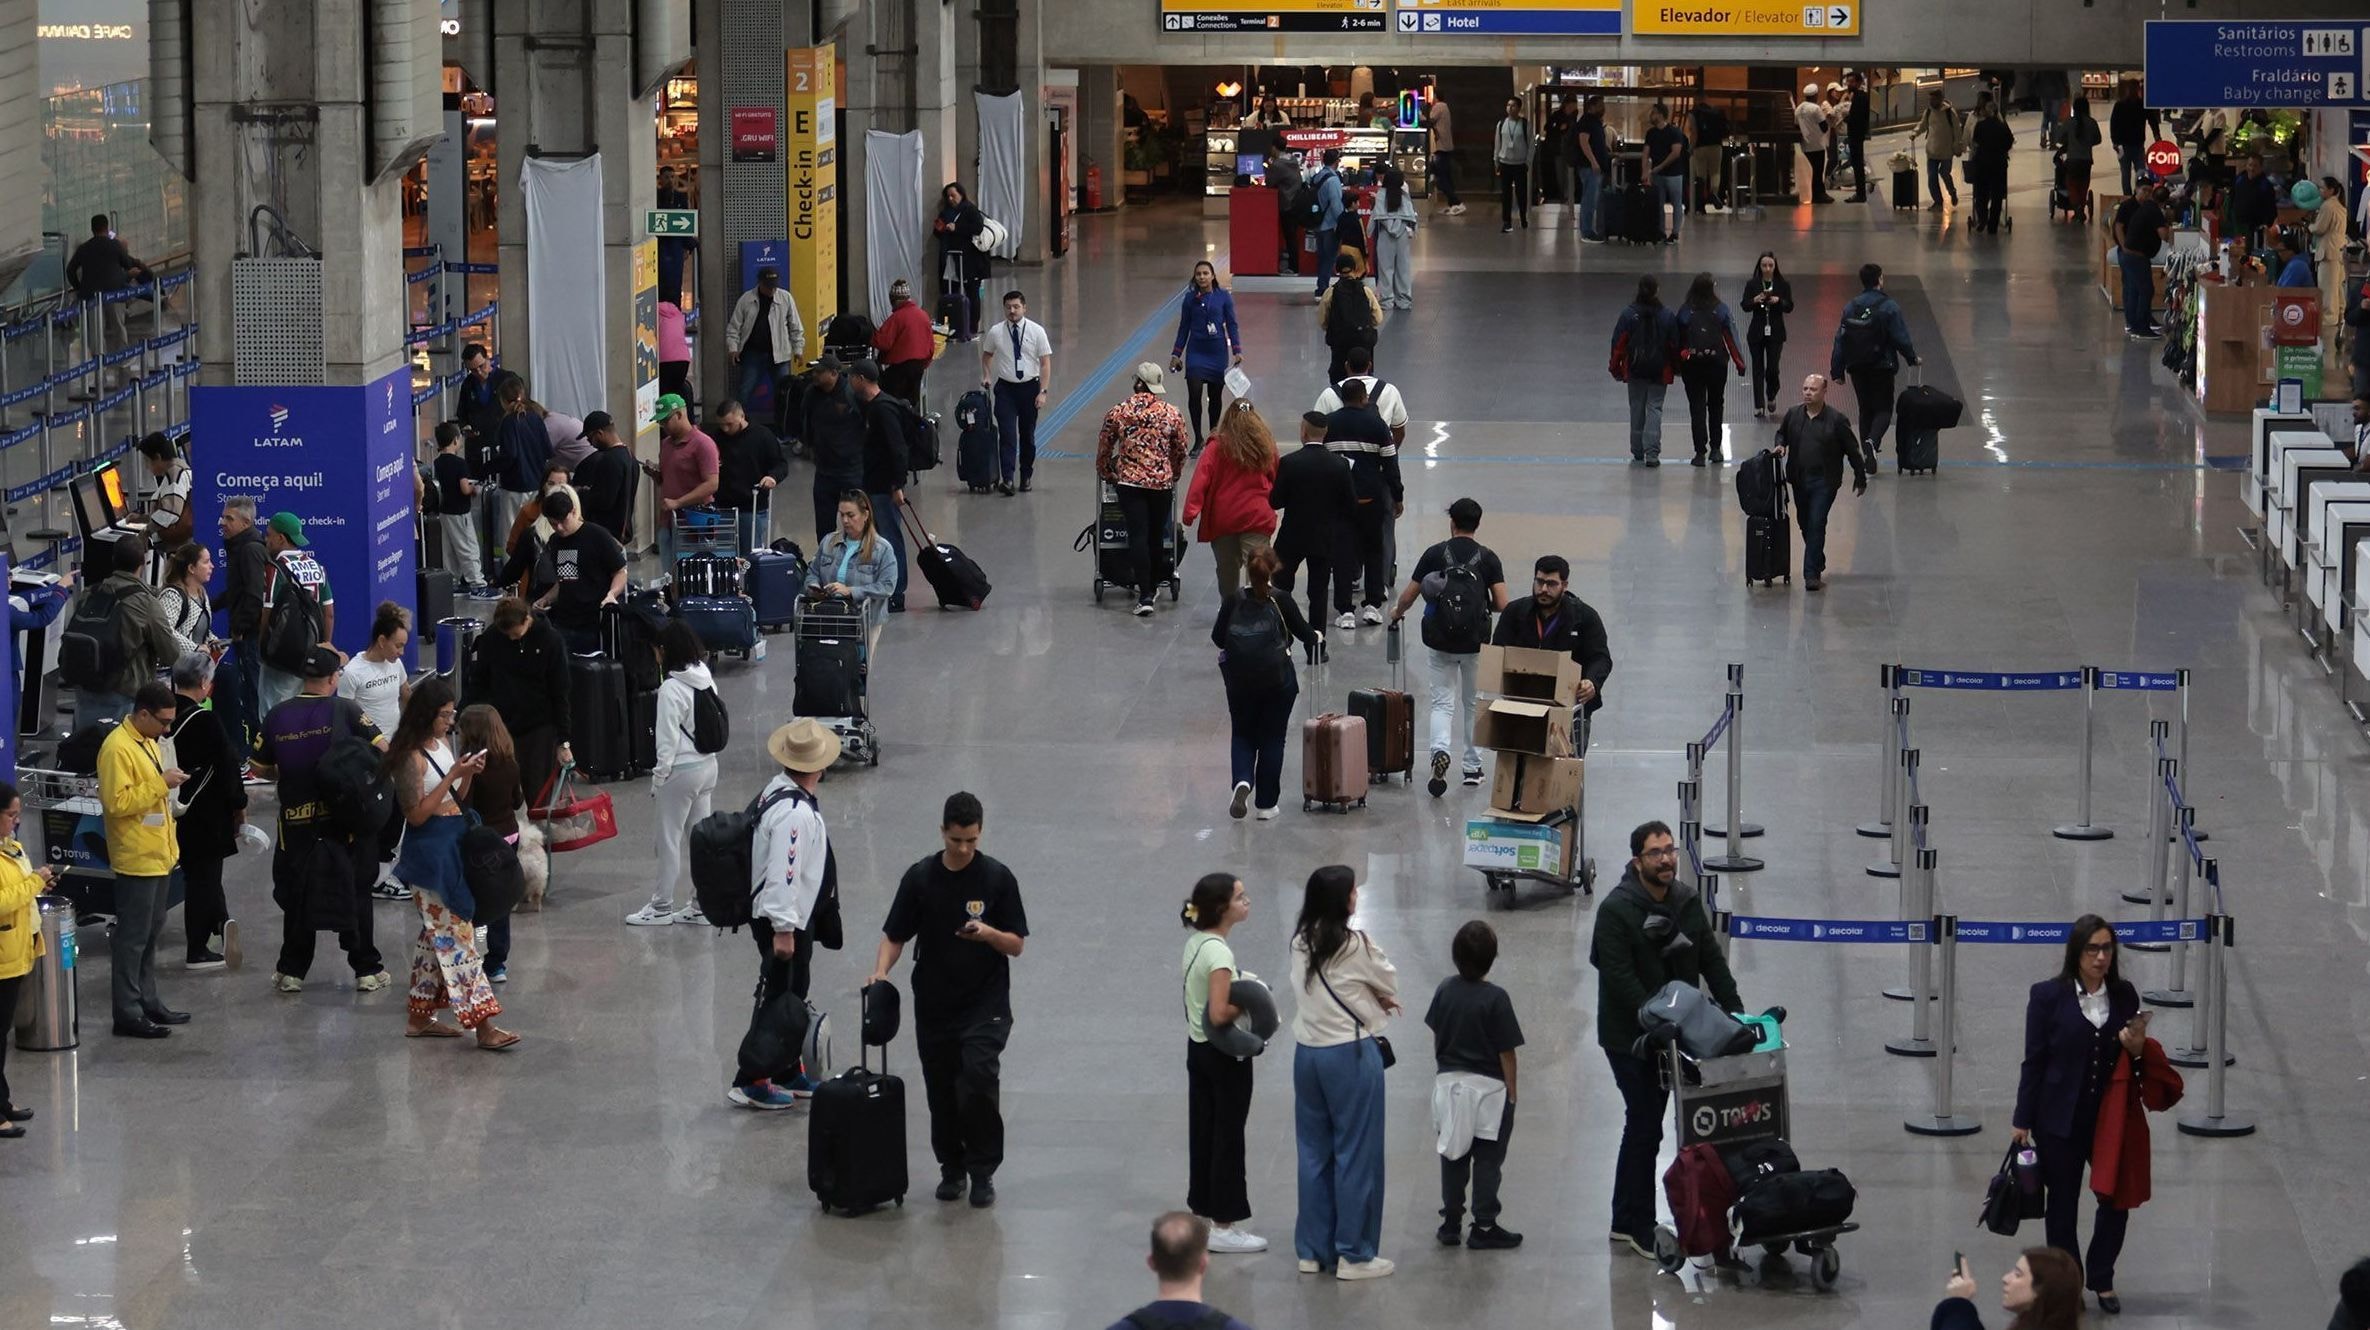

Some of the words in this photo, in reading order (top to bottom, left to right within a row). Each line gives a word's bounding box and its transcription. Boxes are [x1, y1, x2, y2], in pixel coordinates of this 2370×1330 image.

[1196, 14, 1229, 22] Conexões
[1269, 16, 1278, 26] 2
[1352, 18, 1367, 27] 2-6
[1367, 18, 1381, 27] min
[1447, 16, 1479, 28] Hotel
[1660, 8, 1731, 23] Elevador
[1744, 10, 1799, 24] Elevator
[1196, 21, 1238, 29] Connections
[2218, 26, 2296, 41] Sanitários
[2214, 44, 2296, 57] Restrooms
[795, 72, 809, 91] 2
[2252, 69, 2321, 83] Fraldário
[2223, 86, 2262, 102] Baby
[2265, 86, 2322, 103] change
[796, 110, 809, 134] E
[1286, 133, 1338, 141] CHILLIBEANS
[2147, 151, 2180, 165] FOM
[794, 150, 813, 240] Check-in
[383, 419, 397, 434] LATAM
[254, 438, 303, 447] LATAM
[216, 473, 279, 491] Começa
[283, 472, 323, 491] aqui!
[308, 516, 345, 526] check-in
[291, 561, 317, 572] AME
[366, 673, 398, 689] GROWTH
[63, 849, 90, 860] TOTVS
[1468, 843, 1516, 857] Softpaper
[1755, 924, 1791, 933] decolar
[1828, 927, 1864, 935] decolar
[2027, 928, 2062, 937] decolar
